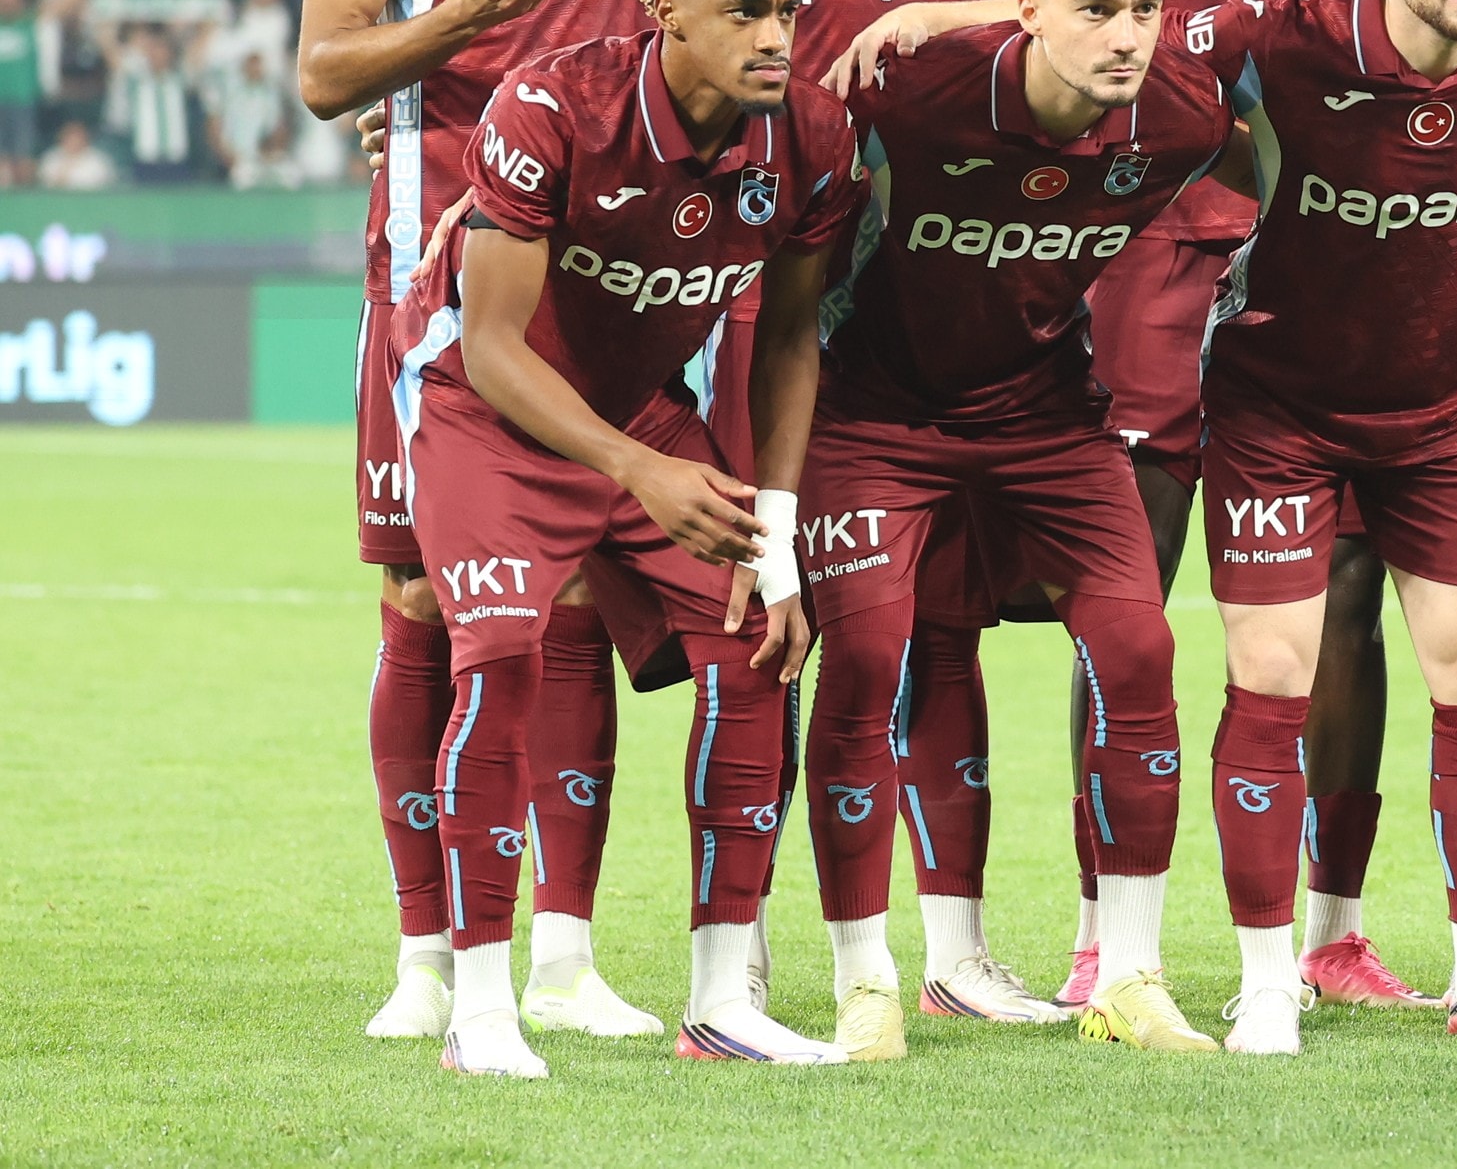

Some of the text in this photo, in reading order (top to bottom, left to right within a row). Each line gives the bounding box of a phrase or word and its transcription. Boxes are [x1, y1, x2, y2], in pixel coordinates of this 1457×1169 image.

[1186, 5, 1222, 55] NB
[483, 122, 545, 192] QNB
[906, 212, 1132, 268] papara
[559, 243, 765, 314] papara
[364, 510, 387, 526] Filo
[802, 509, 888, 558] YKT
[1224, 495, 1311, 538] YKT
[824, 553, 891, 579] Kiralama
[1223, 546, 1314, 564] Filo Kiralama
[441, 556, 532, 603] YKT
[471, 604, 539, 621] Kiralama
